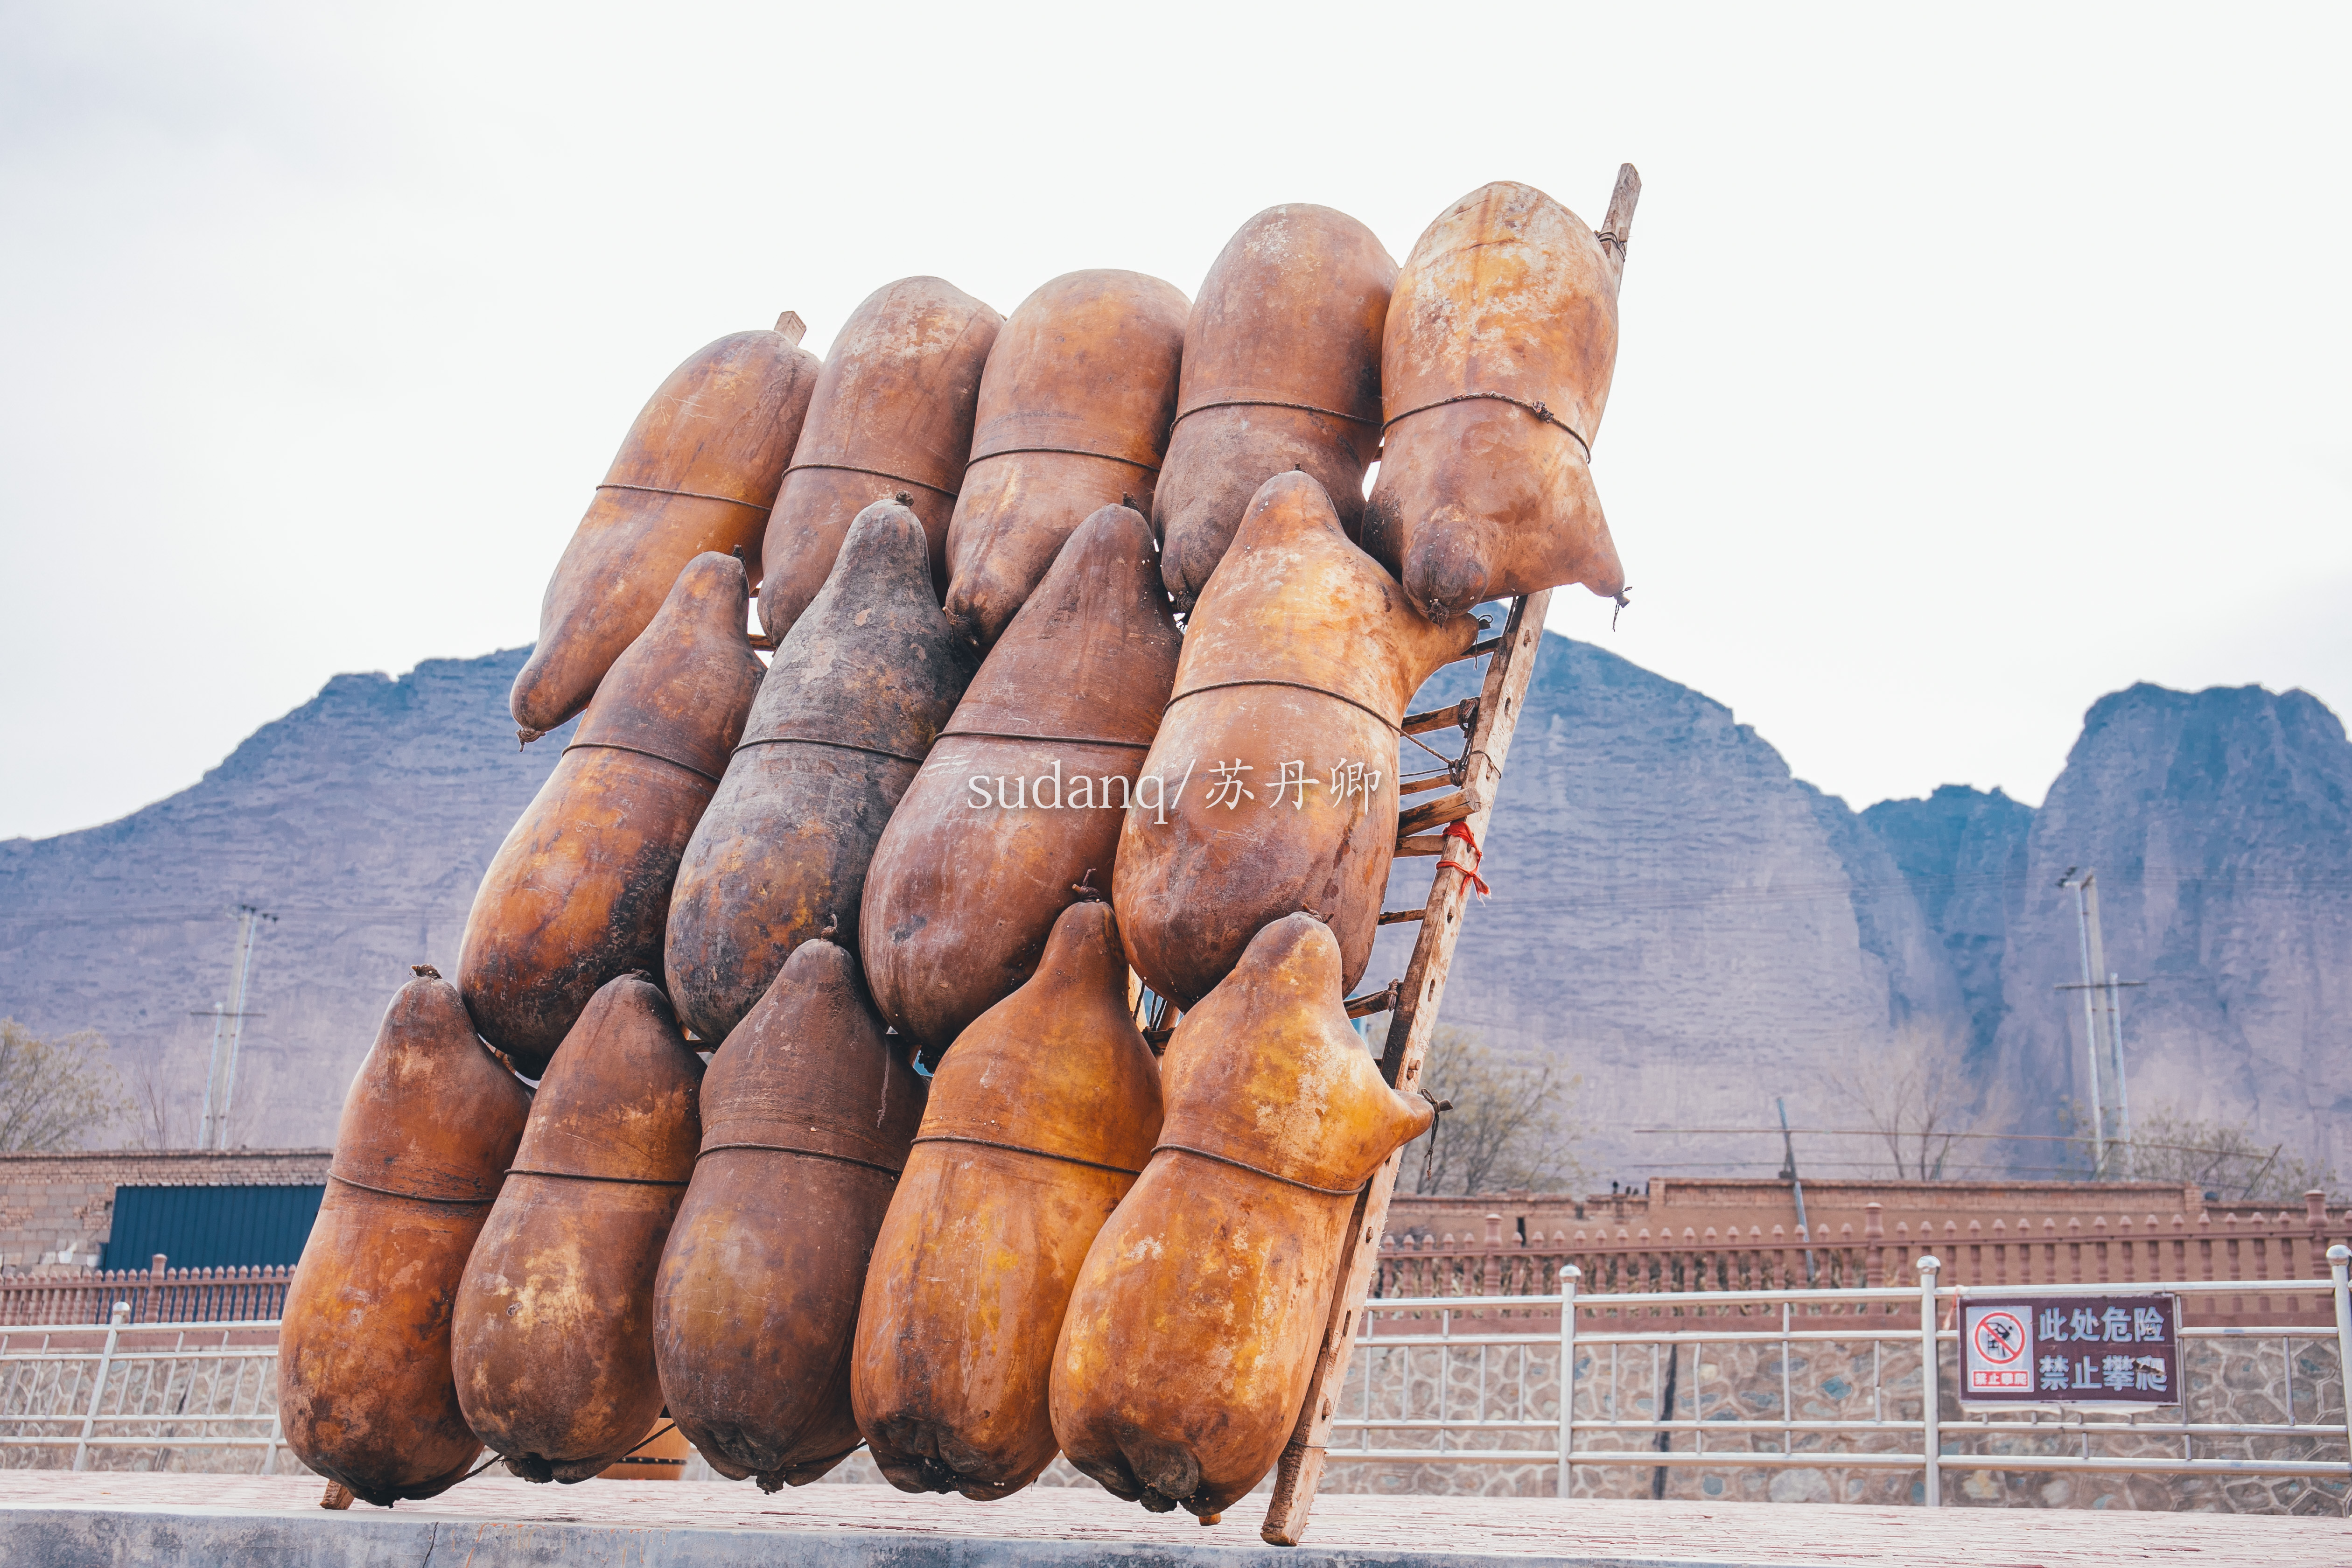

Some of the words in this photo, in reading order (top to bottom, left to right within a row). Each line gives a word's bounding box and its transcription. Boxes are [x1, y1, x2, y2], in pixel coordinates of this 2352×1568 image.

[2038, 1306, 2165, 1342] 此处危险
[2039, 1355, 2168, 1392] 禁止攀爬
